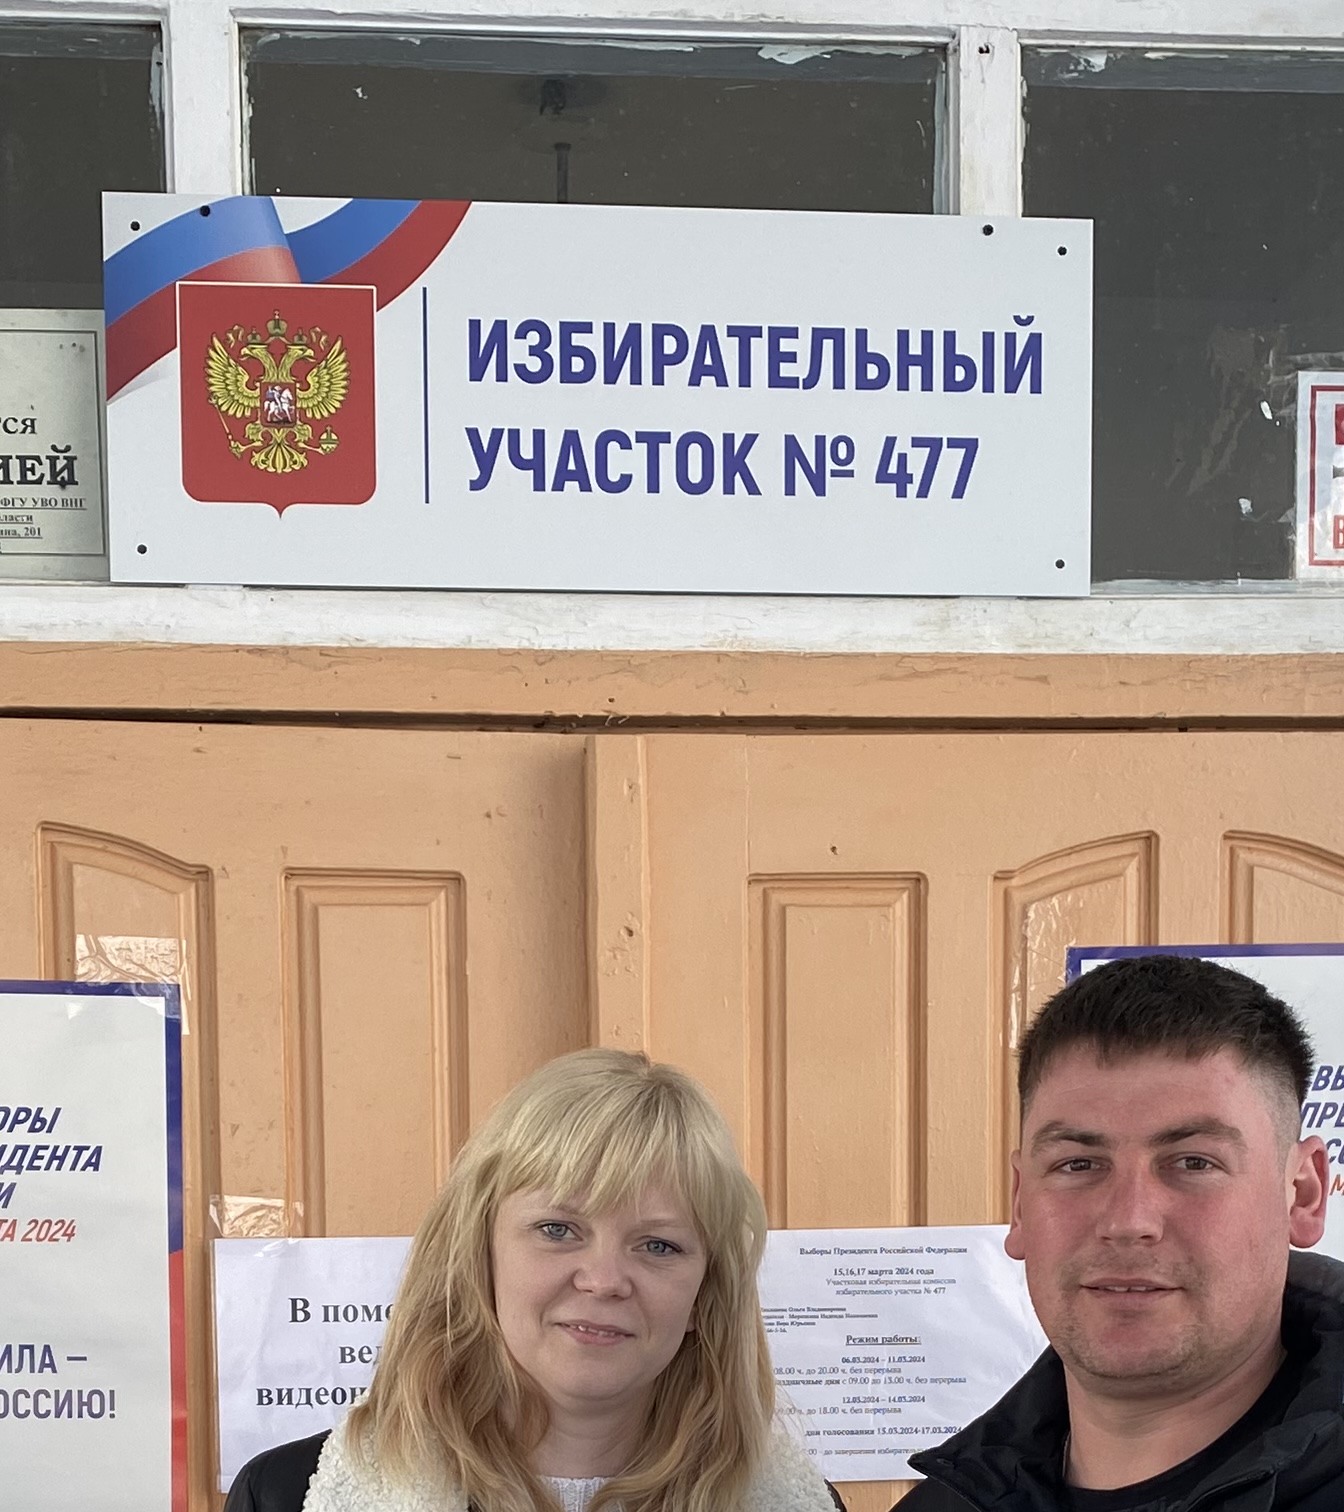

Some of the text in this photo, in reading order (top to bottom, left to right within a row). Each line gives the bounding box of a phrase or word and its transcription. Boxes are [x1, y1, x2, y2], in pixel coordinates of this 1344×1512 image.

[467, 314, 1044, 396] ИЗБИРАТЕЛЬНЫЙ
[465, 427, 980, 501] УЧАСТОК № 477
[0, 497, 27, 508] ФГУ
[31, 497, 58, 508] УВО
[61, 497, 86, 508] ВНГ
[24, 526, 42, 537] 201
[20, 1218, 77, 1243] 2024
[799, 1246, 967, 1256] Выборы Президента Российской Федерации
[867, 1268, 894, 1276] марта
[895, 1267, 914, 1275] 2024
[916, 1268, 935, 1276] года
[826, 1278, 867, 1286] Участковая
[868, 1278, 922, 1286] избирательная
[836, 1287, 893, 1296] избирательного
[894, 1288, 922, 1296] участка
[933, 1286, 947, 1295] 477
[288, 1297, 312, 1323] В
[846, 1334, 922, 1344] Режим работы:
[817, 1366, 840, 1375] 20.00
[849, 1366, 863, 1374] без
[864, 1368, 902, 1376] перерыва
[915, 1376, 929, 1385] без
[849, 1406, 863, 1414] без
[864, 1407, 902, 1415] перерыва
[822, 1428, 875, 1436] голосования
